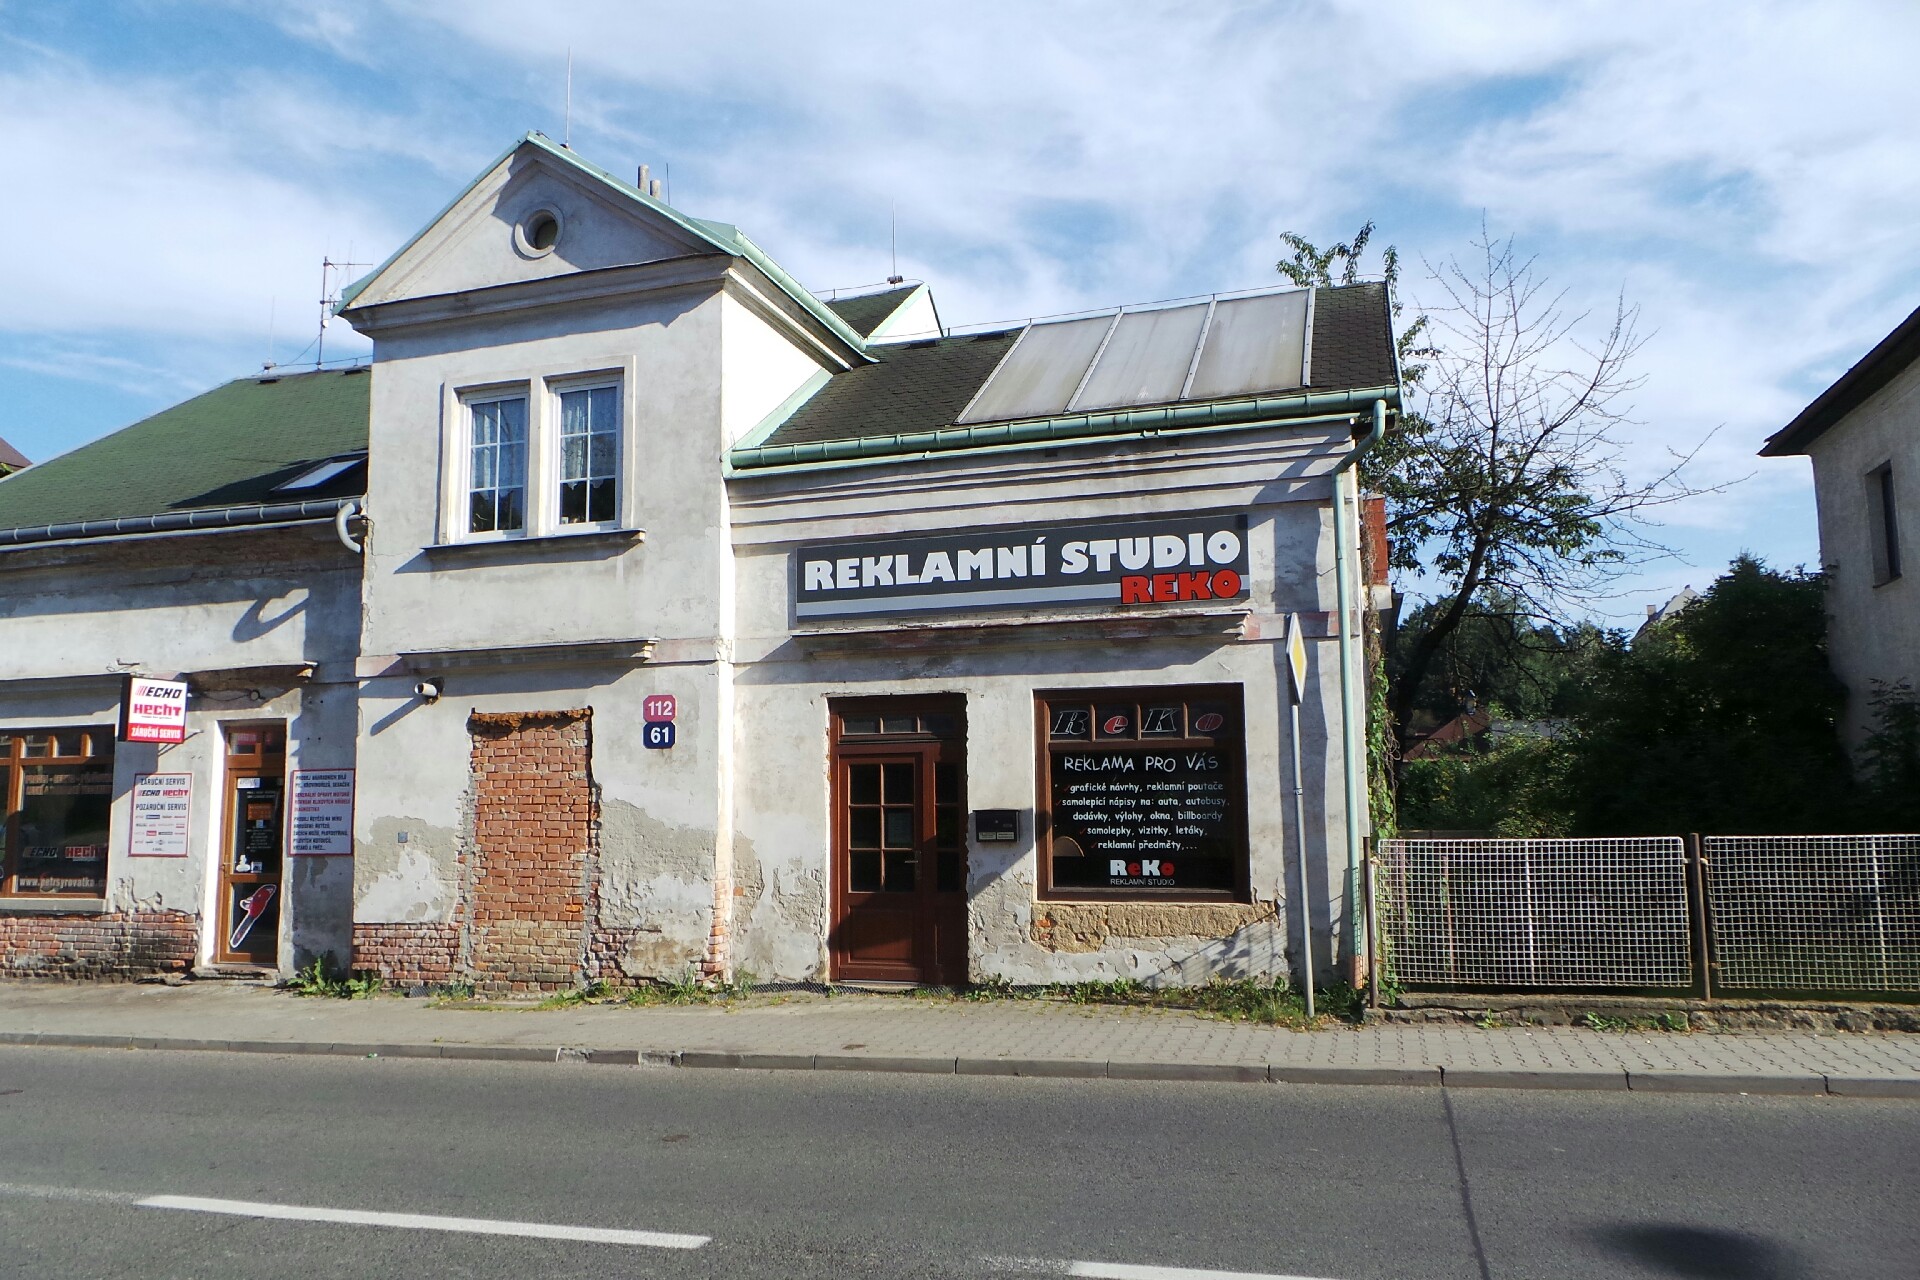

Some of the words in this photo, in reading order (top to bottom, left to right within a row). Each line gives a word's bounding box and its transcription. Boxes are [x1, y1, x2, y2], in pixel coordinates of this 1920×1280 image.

[804, 537, 1046, 591] REKLAMNÍ
[1060, 530, 1241, 574] STUDIO
[1120, 569, 1242, 604] REKO
[145, 686, 183, 699] ECHO
[648, 700, 673, 716] 112
[131, 725, 159, 738] ZÁRUČNÍ
[159, 728, 181, 739] SERVIS
[650, 726, 669, 743] 61
[1064, 754, 1135, 773] REKLAMA
[1145, 756, 1176, 773] PRO
[1186, 751, 1218, 771] VÁS
[141, 777, 164, 785] ZÁRUČNÍ
[1070, 782, 1107, 794] grafické
[1109, 783, 1143, 794] návrhy,
[1146, 782, 1185, 791] reklamní
[1188, 781, 1224, 793] poutače
[167, 803, 187, 811] SERVIS
[1062, 797, 1106, 808] samolepící
[1109, 798, 1136, 808] nápisy
[1140, 798, 1154, 806] na:
[1158, 798, 1182, 807] auta,
[1073, 811, 1111, 822] dodávky,
[1115, 811, 1146, 822] výlohy,
[1150, 812, 1174, 821] okna,
[1178, 811, 1223, 822] billboardy
[1086, 826, 1135, 837] samolepky,
[1138, 825, 1172, 837] vizitky,
[1098, 839, 1135, 849] reklamní
[30, 847, 57, 858] ECHO
[1110, 878, 1147, 886] REKLAMNÍ
[1147, 878, 1175, 886] STUDIO
